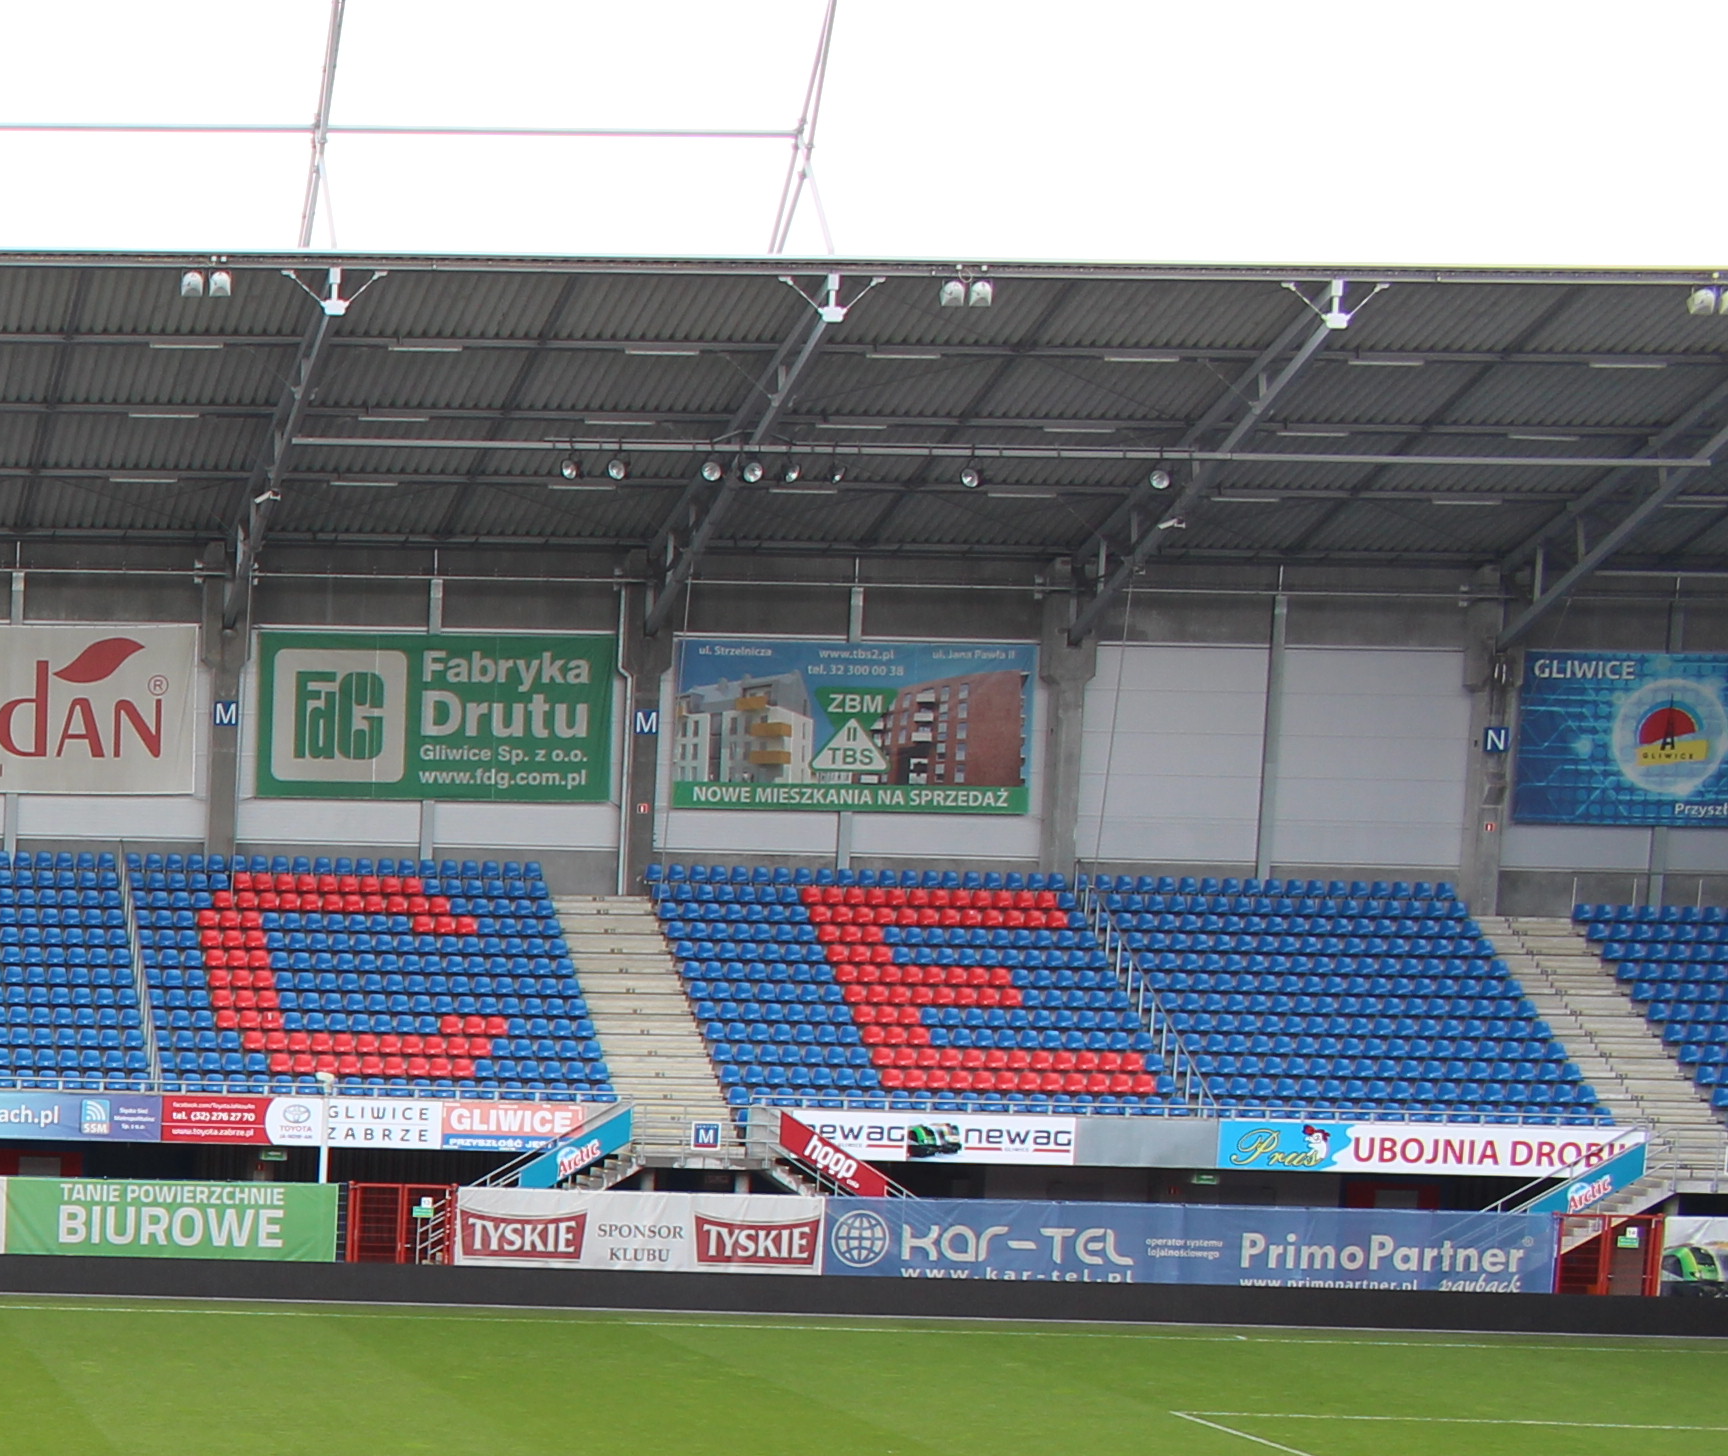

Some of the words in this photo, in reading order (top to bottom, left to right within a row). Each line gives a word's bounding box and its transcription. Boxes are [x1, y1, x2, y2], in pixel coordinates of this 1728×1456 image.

[714, 646, 772, 657] Strzelnicza
[818, 647, 894, 660] www.tbs2.pl
[422, 650, 590, 692] Fabryka
[808, 664, 827, 675] tel.
[830, 665, 844, 675] 32
[847, 666, 869, 676] 300
[888, 666, 904, 677] 38
[1534, 659, 1636, 680] GLIWICE
[828, 694, 883, 714] ZBM
[216, 705, 236, 724] M
[420, 690, 588, 739] Drutu
[637, 713, 657, 733] M
[420, 744, 492, 761] Gliwice
[497, 746, 529, 764] Sp.
[535, 749, 545, 761] z
[552, 748, 587, 762] o.o.
[828, 747, 873, 766] TBS
[419, 768, 586, 790] www.fdg.com.pl
[693, 786, 750, 803] NOWE
[756, 787, 873, 806] MIESZKANIA
[878, 789, 904, 805] NA
[910, 787, 1009, 807] SPRZEDAŻ
[191, 1112, 210, 1122] (32)
[212, 1112, 229, 1121] 276
[230, 1113, 241, 1121] 27
[243, 1113, 255, 1122] 70
[328, 1105, 429, 1121] GLIWICE
[450, 1108, 572, 1133] GLIWICE
[83, 1124, 108, 1134] SSM
[172, 1128, 254, 1138] www.toyota.zabrze.pl
[328, 1127, 429, 1143] ZABRZE
[964, 1127, 1072, 1147] newag
[449, 1138, 522, 1148] PRZYSZŁOŚĆ
[1353, 1138, 1499, 1167] UBOJNIA
[803, 1135, 858, 1178] hoop
[60, 1184, 121, 1202] TANIE
[127, 1184, 285, 1205] POWIERZCHNIE
[58, 1205, 284, 1248] BIUROWE
[468, 1219, 578, 1253] TYSKIE
[597, 1223, 683, 1239] SPONSOR
[703, 1225, 811, 1259] TYSKIE
[1146, 1237, 1185, 1248] operator
[1186, 1239, 1223, 1249] systemu
[609, 1248, 670, 1263] KLUBU
